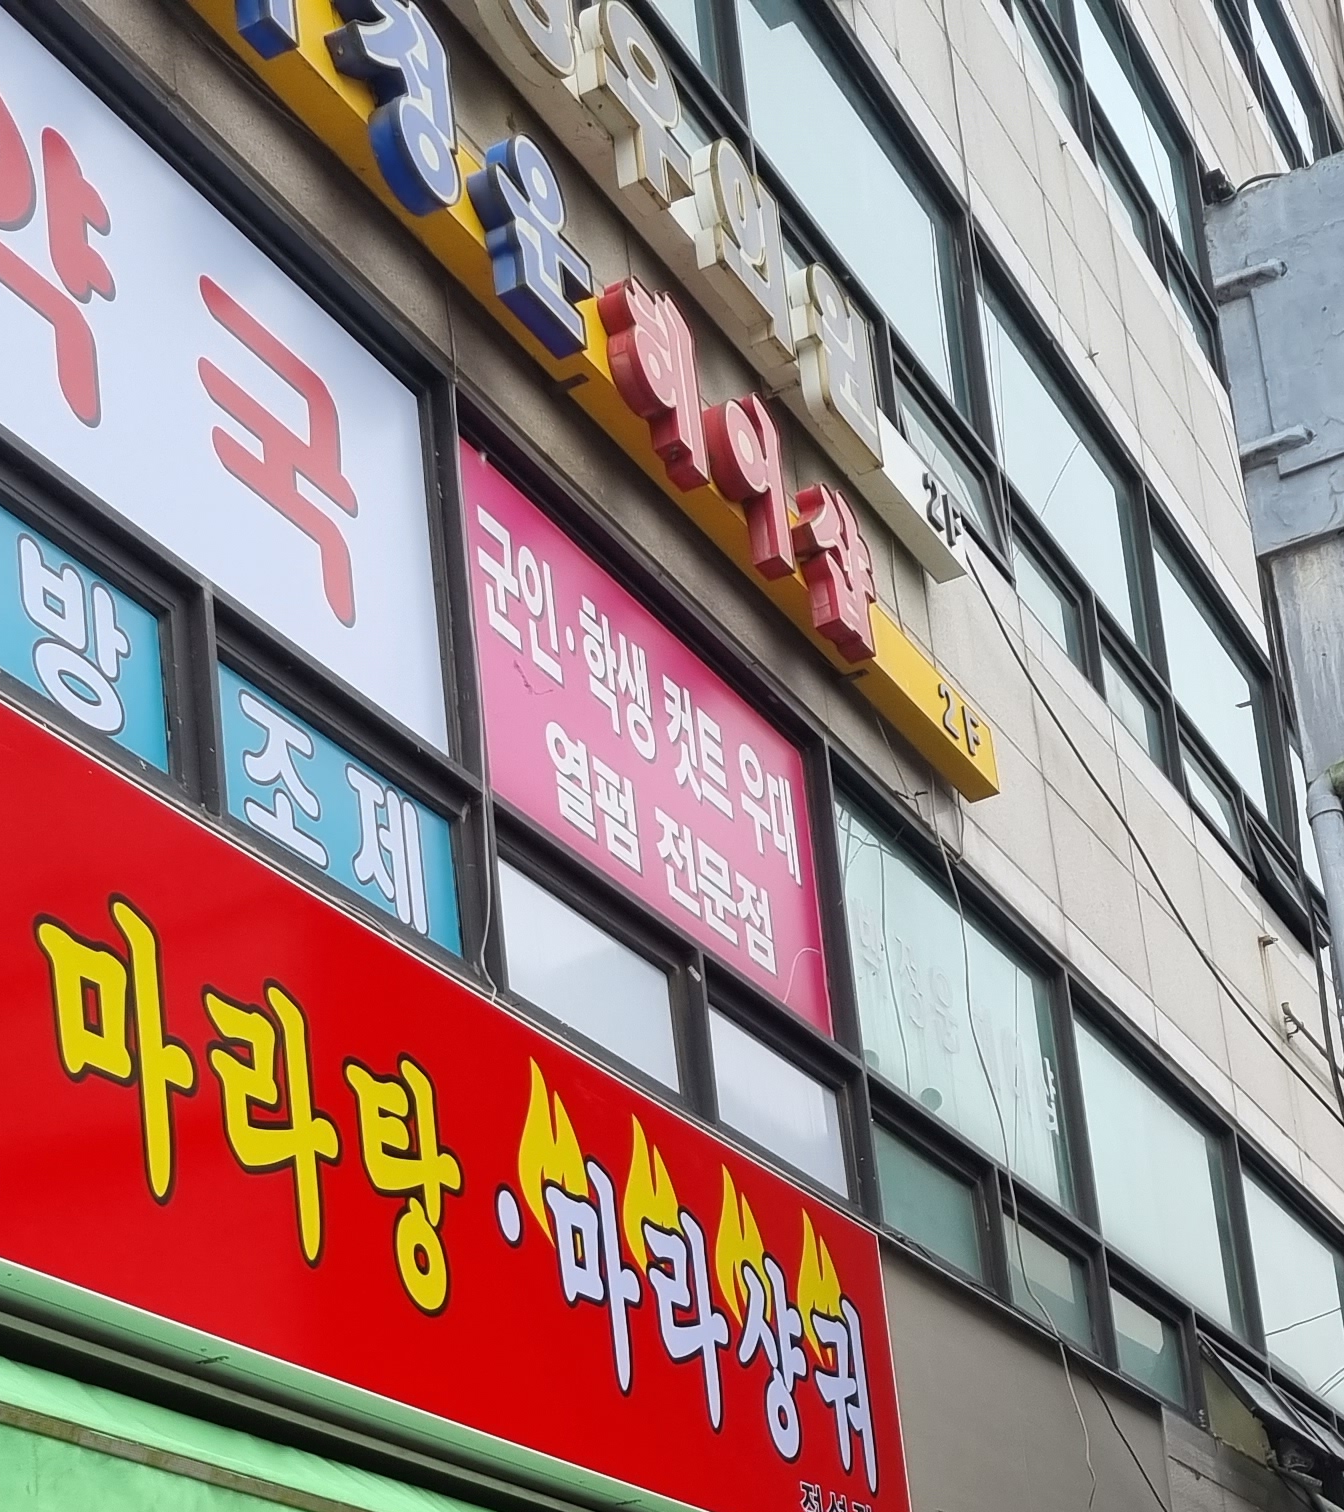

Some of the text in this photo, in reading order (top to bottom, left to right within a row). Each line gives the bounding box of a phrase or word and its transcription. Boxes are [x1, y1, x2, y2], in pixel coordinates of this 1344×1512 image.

[488, 0, 964, 546] 우의원 2F
[239, 689, 429, 937] 조제
[663, 674, 734, 820] 컷트
[738, 743, 802, 886] 우대
[938, 683, 982, 756] 2F
[546, 721, 777, 976] 열펌 전문점
[34, 894, 463, 1315] 마라탕
